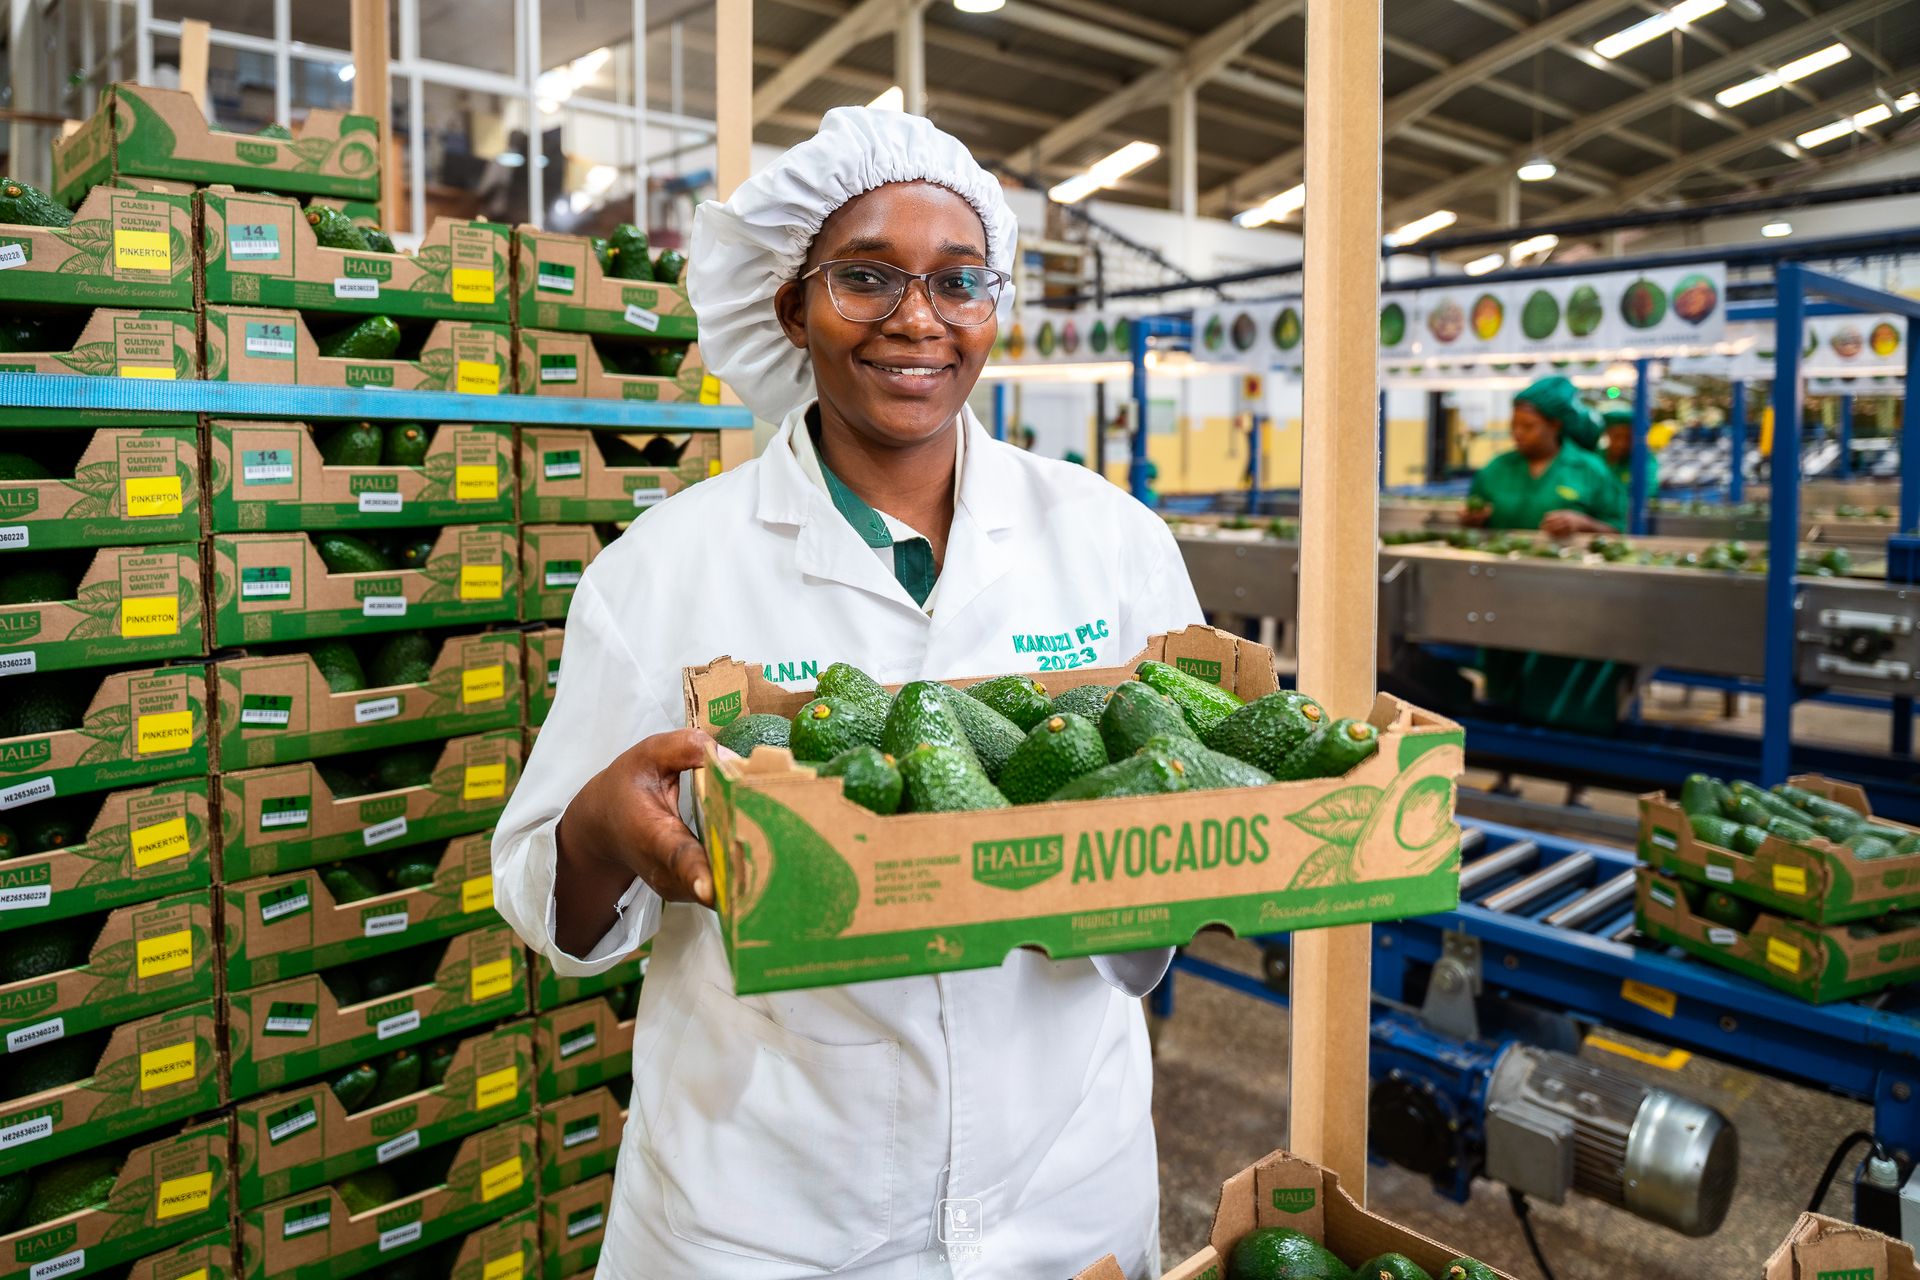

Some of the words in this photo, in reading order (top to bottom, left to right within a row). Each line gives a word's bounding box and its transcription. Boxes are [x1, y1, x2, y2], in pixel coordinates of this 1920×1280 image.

[121, 201, 149, 211] CLASS
[151, 202, 156, 211] 1
[121, 217, 161, 228] CULTIVAR
[243, 225, 265, 237] 14
[120, 247, 168, 258] PINKERTON
[346, 259, 391, 276] HALLS
[75, 280, 130, 295] Passionate
[131, 286, 158, 297] since
[123, 322, 150, 331] CLASS
[153, 323, 159, 331] 1
[261, 324, 282, 336] 14
[124, 338, 165, 347] CULTIVAR
[348, 368, 392, 382] HALLS
[126, 440, 153, 449] CLASS
[156, 440, 161, 448] 1
[127, 456, 168, 465] CULTIVAR
[258, 450, 279, 462] 14
[352, 477, 395, 490] HALLS
[131, 492, 179, 504] PINKERTON
[128, 558, 155, 567] CLASS
[129, 573, 170, 583] CULTIVAR
[259, 567, 278, 578] 14
[356, 581, 401, 595] HALLS
[126, 613, 174, 624] PINKERTON
[1012, 632, 1074, 654] KAKUZI
[1075, 619, 1109, 645] PLC
[1036, 646, 1098, 672] 2023
[1178, 661, 1220, 675] HALLS
[138, 693, 179, 705] CULTIVAR
[709, 694, 740, 718] HALLS
[142, 727, 190, 740] PINKERTON
[4, 783, 51, 804] HE265360228
[138, 834, 186, 855] PINKERTON
[976, 840, 1061, 872] HALLS
[1071, 813, 1270, 884] AVOCADOS
[1, 891, 48, 904] HE265360228
[1121, 910, 1134, 925] OF
[1137, 907, 1170, 924] KENYA
[1258, 898, 1330, 925] Passionate
[142, 948, 190, 965] PINKERTON
[13, 1024, 60, 1045] HE265360228
[144, 1058, 192, 1078] PINKERTON
[2, 1122, 49, 1143] HE265360228
[1275, 1191, 1314, 1204] HALLS
[18, 1227, 75, 1257] HALLS
